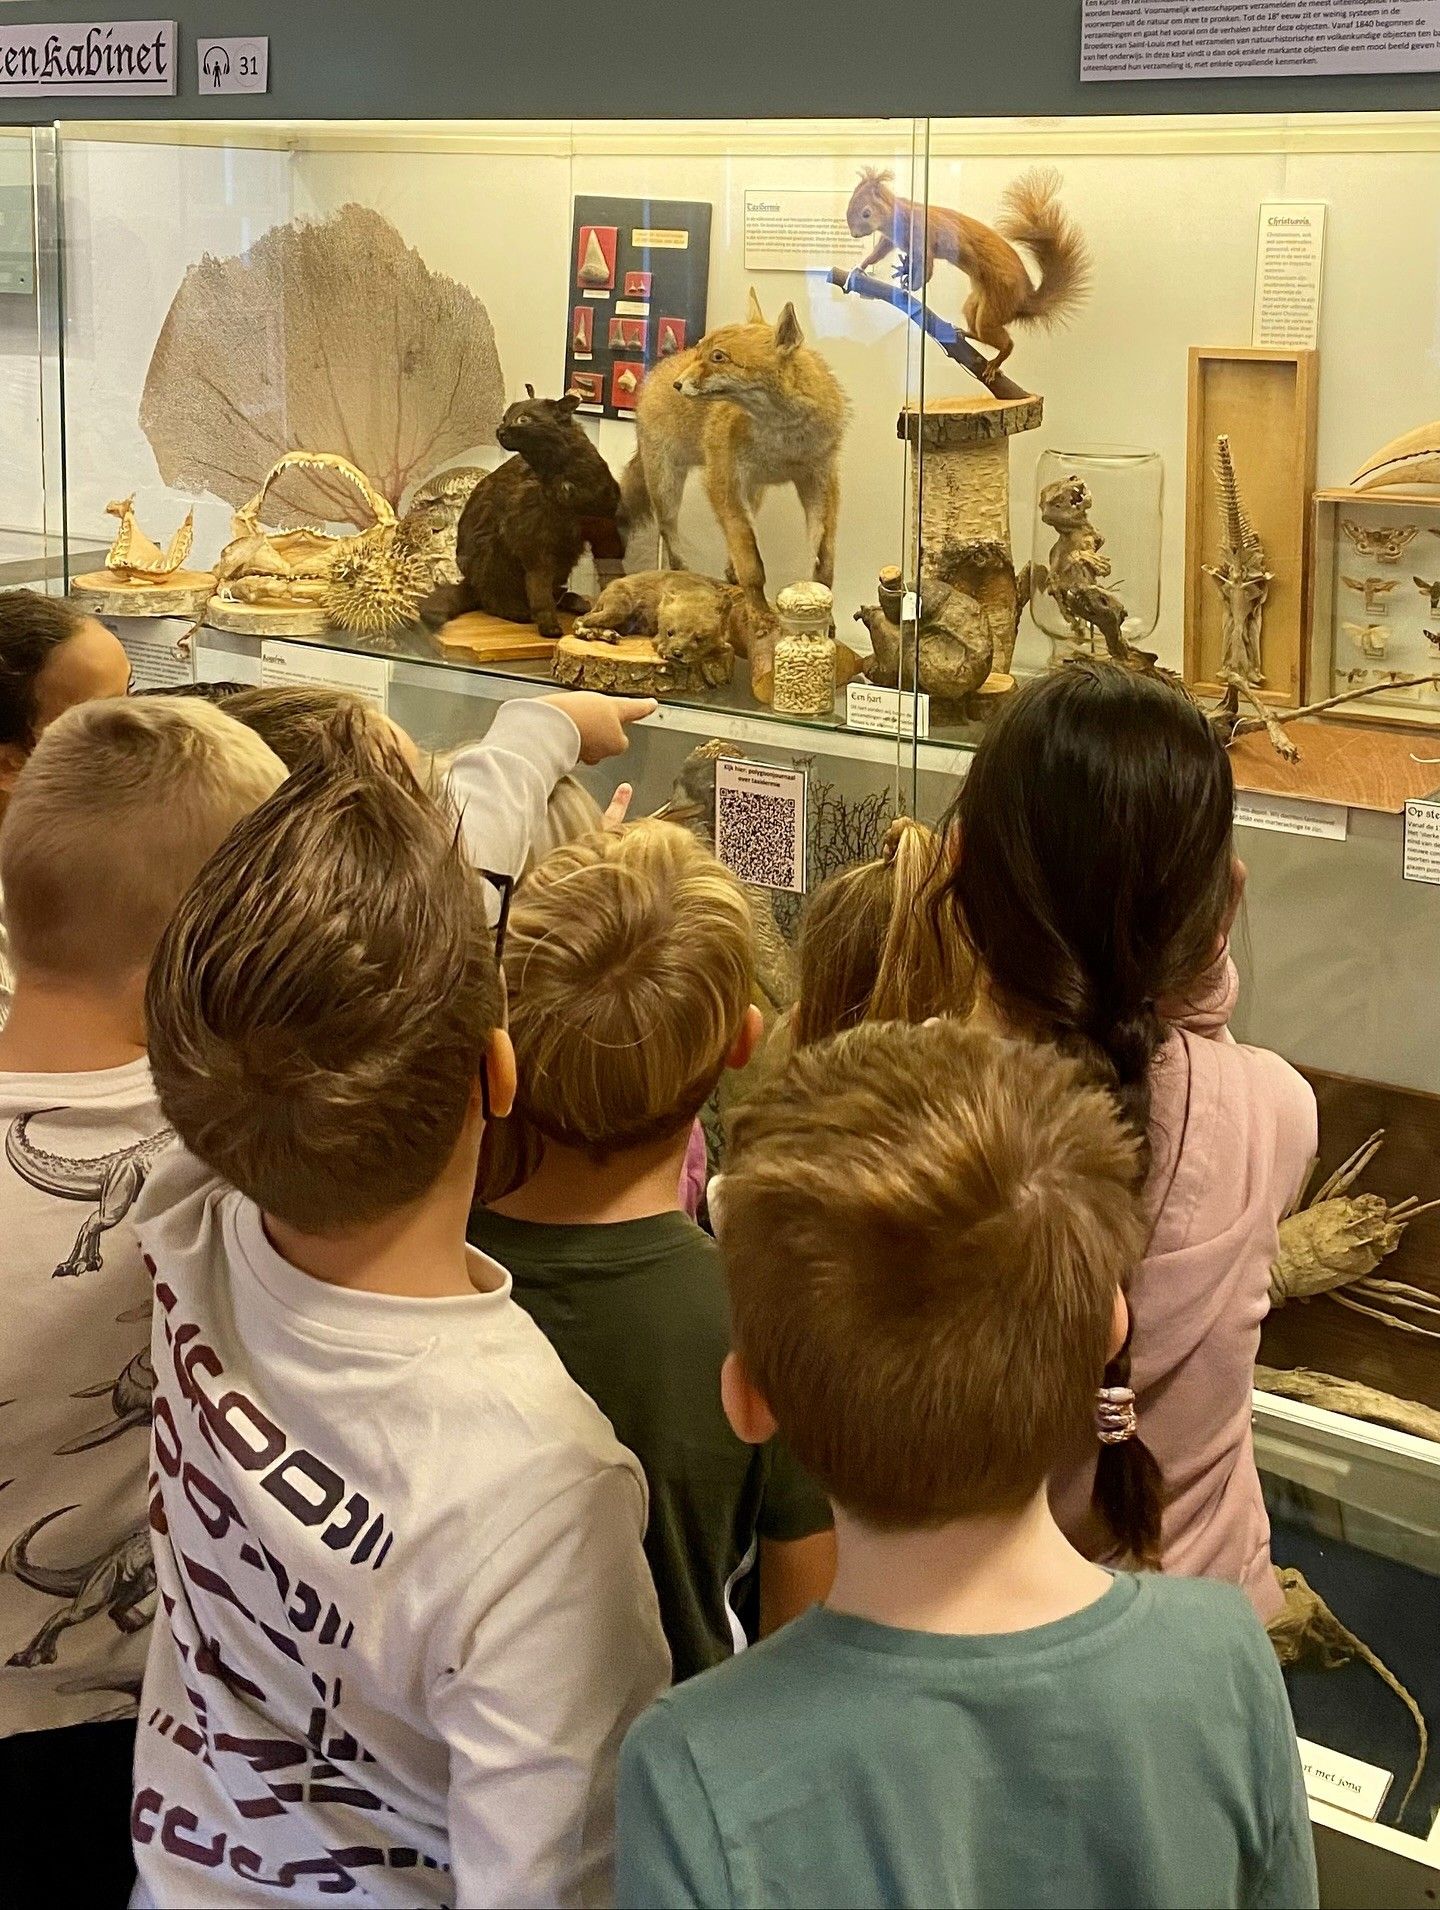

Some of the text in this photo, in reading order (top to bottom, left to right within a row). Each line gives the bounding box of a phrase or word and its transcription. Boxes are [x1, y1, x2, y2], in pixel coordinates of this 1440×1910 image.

[1085, 9, 1110, 17] worden
[1112, 7, 1142, 16] bewaard.
[1192, 4, 1248, 13] wetenschappers
[1250, 1, 1296, 10] verzamelden
[1297, 0, 1307, 8] de
[1085, 20, 1125, 28] voorwerpen
[1126, 18, 1135, 26] uit
[1136, 18, 1146, 26] de
[1147, 17, 1169, 25] natuur
[1201, 15, 1209, 23] te
[1210, 14, 1241, 23] pronken.
[1244, 13, 1255, 21] Tot
[1257, 13, 1266, 21] de
[1303, 11, 1312, 19] zit
[1323, 10, 1347, 19] weinig
[1349, 9, 1380, 18] systeem
[1390, 7, 1401, 15] de
[1085, 30, 1132, 39] verzamelingen
[1144, 28, 1158, 37] gaat
[1160, 28, 1171, 36] het
[1173, 27, 1195, 35] vooral
[1209, 26, 1218, 34] de
[1221, 25, 1251, 33] verhalen
[1252, 24, 1275, 32] achter
[1276, 23, 1294, 31] deze
[1295, 22, 1329, 31] objecten.
[1332, 21, 1353, 29] Vanaf
[1355, 20, 1374, 28] 1840
[1375, 19, 1414, 28] begonnen
[1415, 18, 1426, 26] de
[1084, 42, 1113, 50] Broeders
[1129, 40, 1165, 48] Saint-Louis
[1166, 39, 1179, 47] met
[1182, 38, 1193, 46] het
[1195, 37, 1235, 46] verzamelen
[1251, 35, 1314, 44] natuurhistorische
[1327, 32, 1381, 41] volkenkundige
[1382, 31, 1416, 40] objecten
[1418, 29, 1431, 37] ten
[0, 27, 168, 77] enkabinet
[1096, 52, 1107, 60] het
[1108, 51, 1143, 60] onderwijs.
[1146, 50, 1152, 58] In
[1153, 50, 1170, 58] deze
[1171, 49, 1185, 57] kast
[1187, 49, 1204, 57] vindt
[1212, 48, 1226, 56] dan
[1227, 47, 1240, 55] ook
[1242, 47, 1266, 55] enkele
[1267, 46, 1302, 54] markante
[1303, 44, 1336, 53] objecten
[1338, 43, 1349, 51] die
[1366, 42, 1386, 50] mooi
[1388, 41, 1409, 50] beeld
[1411, 42, 1435, 50] geven
[239, 56, 258, 76] 31
[1083, 57, 1318, 72] uiteenlopend hun verzameling is, met enkele opvallende kenmerken.
[851, 692, 882, 704] Een hart
[724, 764, 734, 772] Kijk
[751, 778, 781, 788] taxidermie
[1408, 806, 1423, 818] Op
[1315, 1769, 1336, 1782] met
[1338, 1778, 1361, 1793] jong
